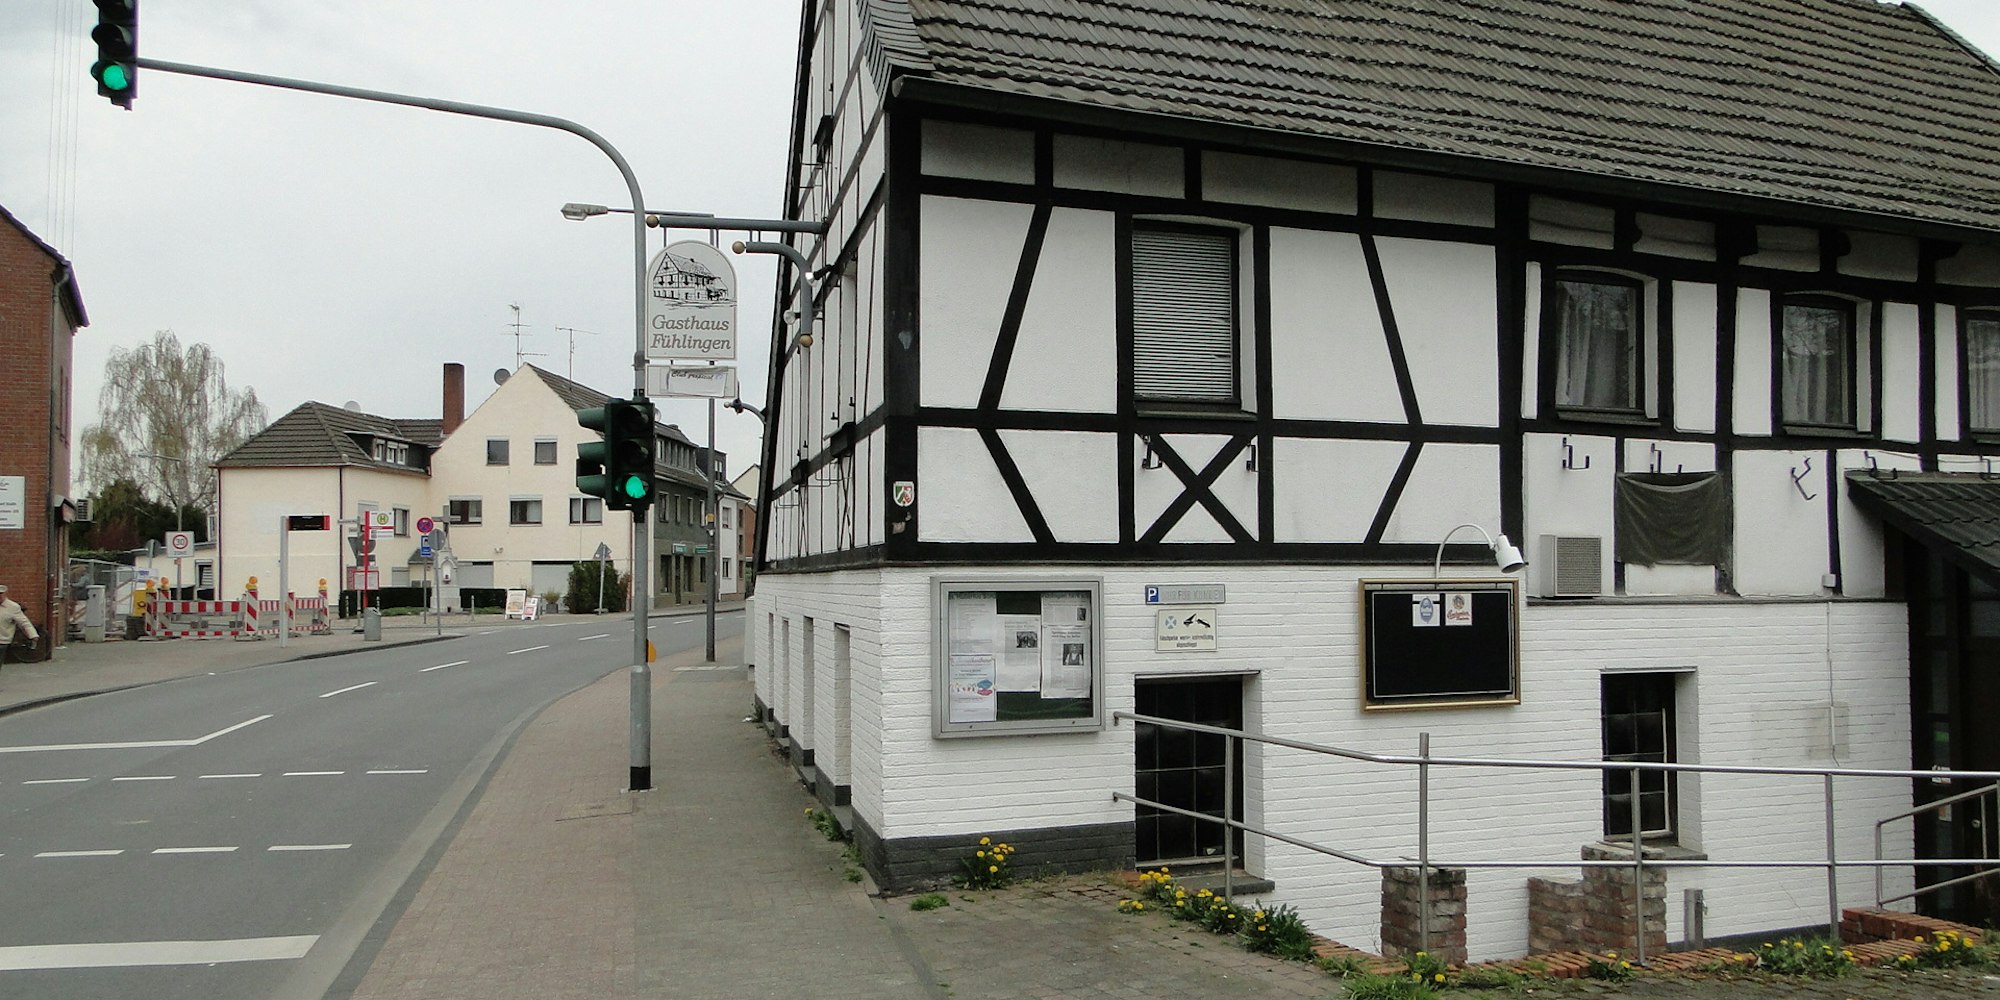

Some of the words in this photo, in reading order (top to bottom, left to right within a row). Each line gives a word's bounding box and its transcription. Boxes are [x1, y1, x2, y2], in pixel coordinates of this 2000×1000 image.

[652, 314, 730, 331] Gasthaus
[650, 333, 731, 353] Fühlingen
[176, 538, 185, 546] 30
[1147, 587, 1157, 602] P
